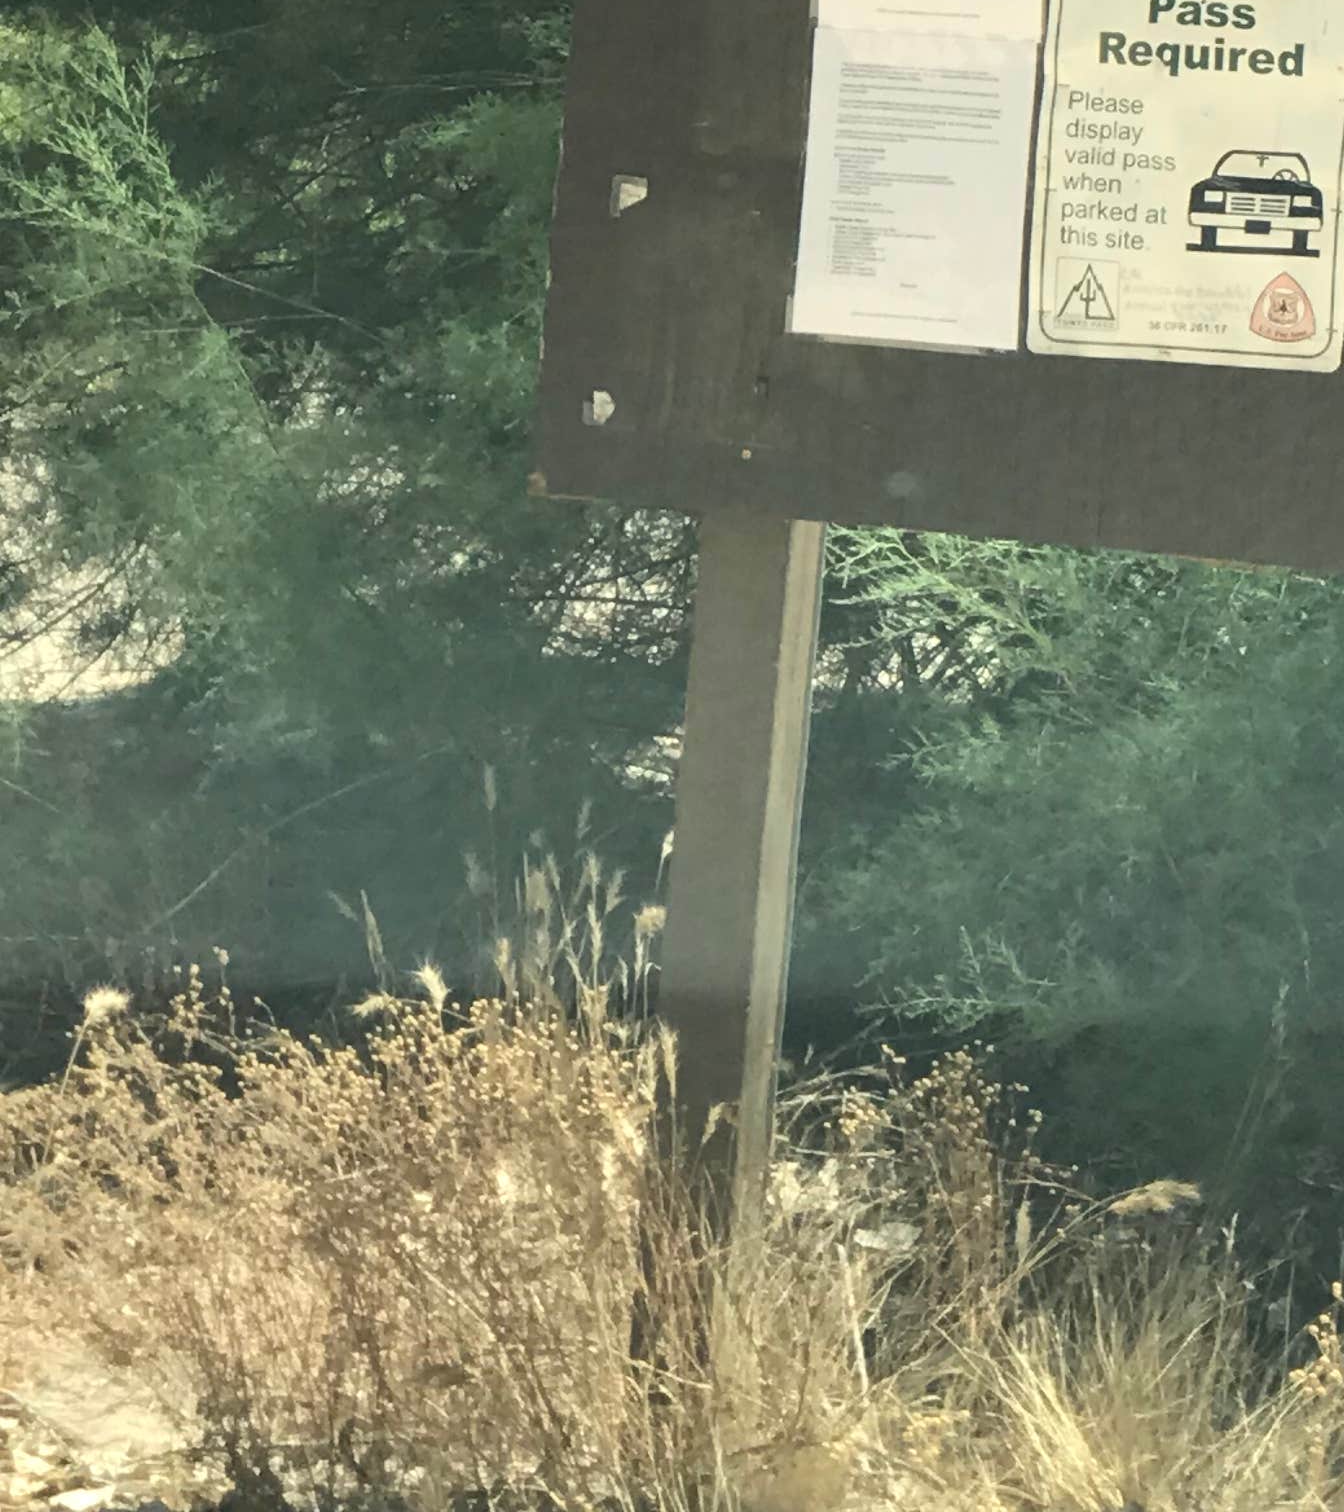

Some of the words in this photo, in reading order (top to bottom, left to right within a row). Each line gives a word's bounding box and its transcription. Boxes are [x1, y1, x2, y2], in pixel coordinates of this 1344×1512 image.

[1100, 32, 1304, 76] Required
[1068, 90, 1143, 114] Please
[1066, 118, 1143, 146] display
[1065, 147, 1116, 166] valid
[1122, 153, 1176, 172] pass
[1064, 172, 1122, 194] when
[1061, 200, 1138, 222] parked
[1145, 207, 1166, 224] at
[1060, 225, 1098, 247] this
